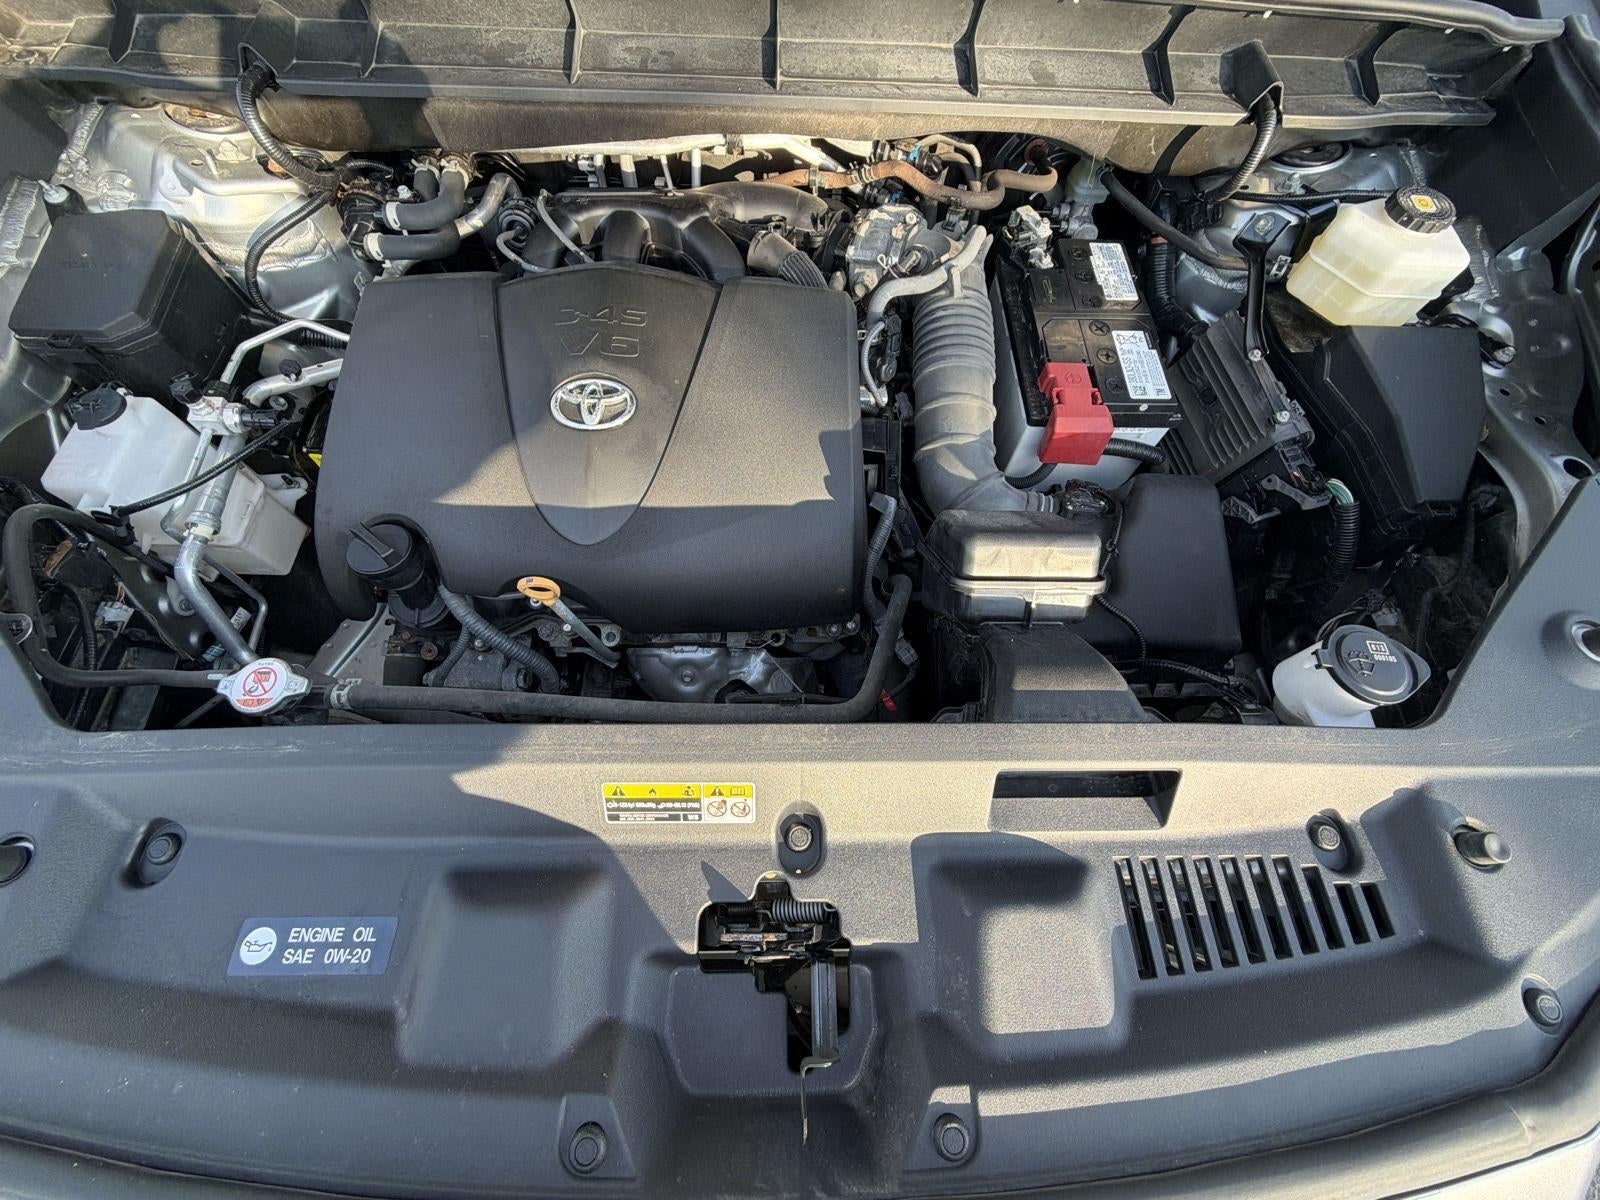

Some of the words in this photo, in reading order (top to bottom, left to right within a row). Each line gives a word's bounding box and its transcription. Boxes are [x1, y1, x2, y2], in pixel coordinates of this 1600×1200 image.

[560, 332, 640, 358] V6
[288, 927, 345, 943] ENGINE
[353, 926, 377, 943] OIL
[282, 948, 315, 964] SAE
[324, 948, 371, 964] 0W-20
